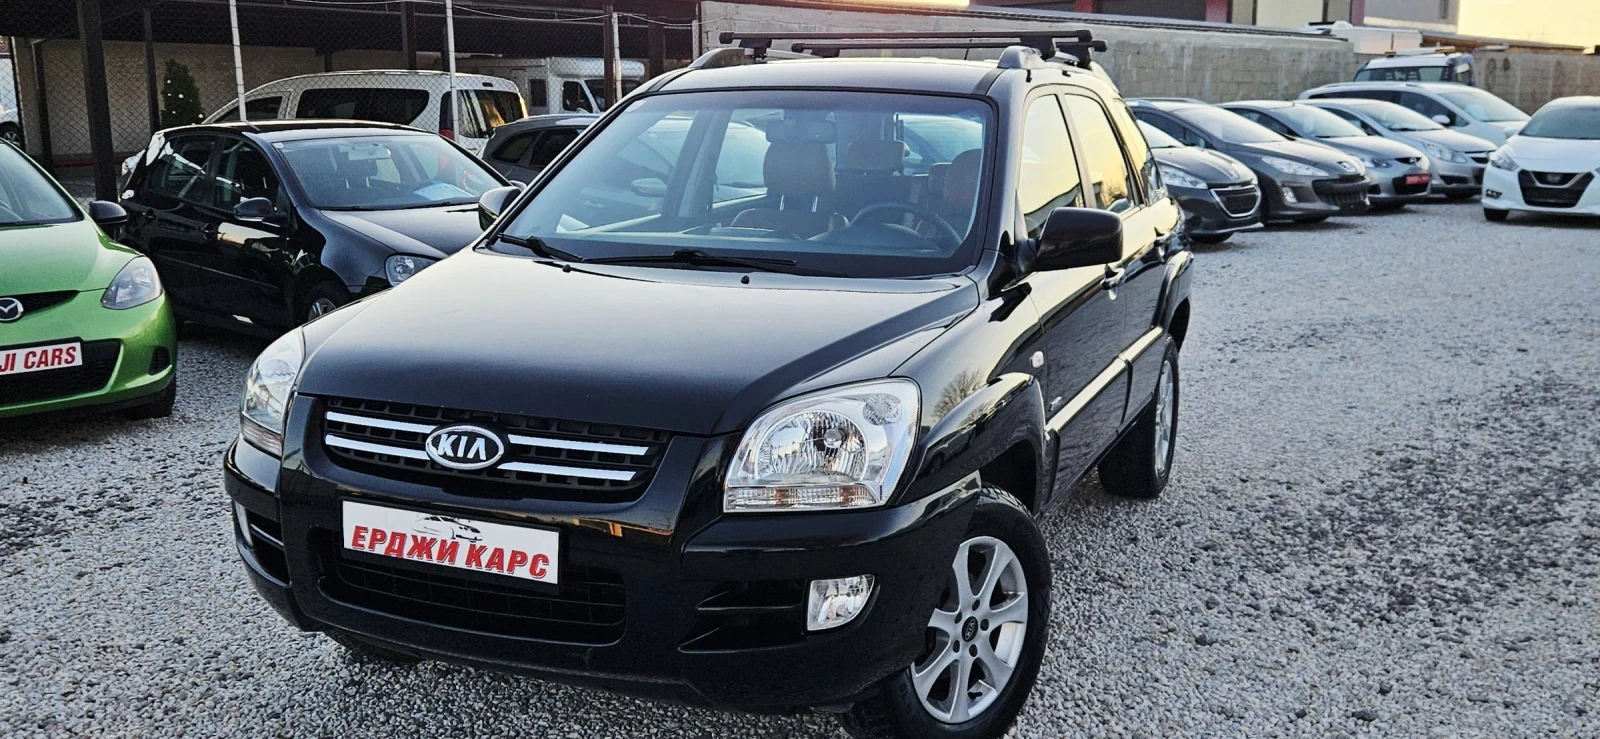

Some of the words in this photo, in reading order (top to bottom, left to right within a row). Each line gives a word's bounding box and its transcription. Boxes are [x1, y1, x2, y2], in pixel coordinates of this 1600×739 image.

[24, 346, 76, 369] CARS
[438, 434, 486, 460] KIA
[351, 525, 460, 565] ЕРДЖИ
[465, 543, 549, 579] КАРС
[965, 618, 976, 641] KIA
